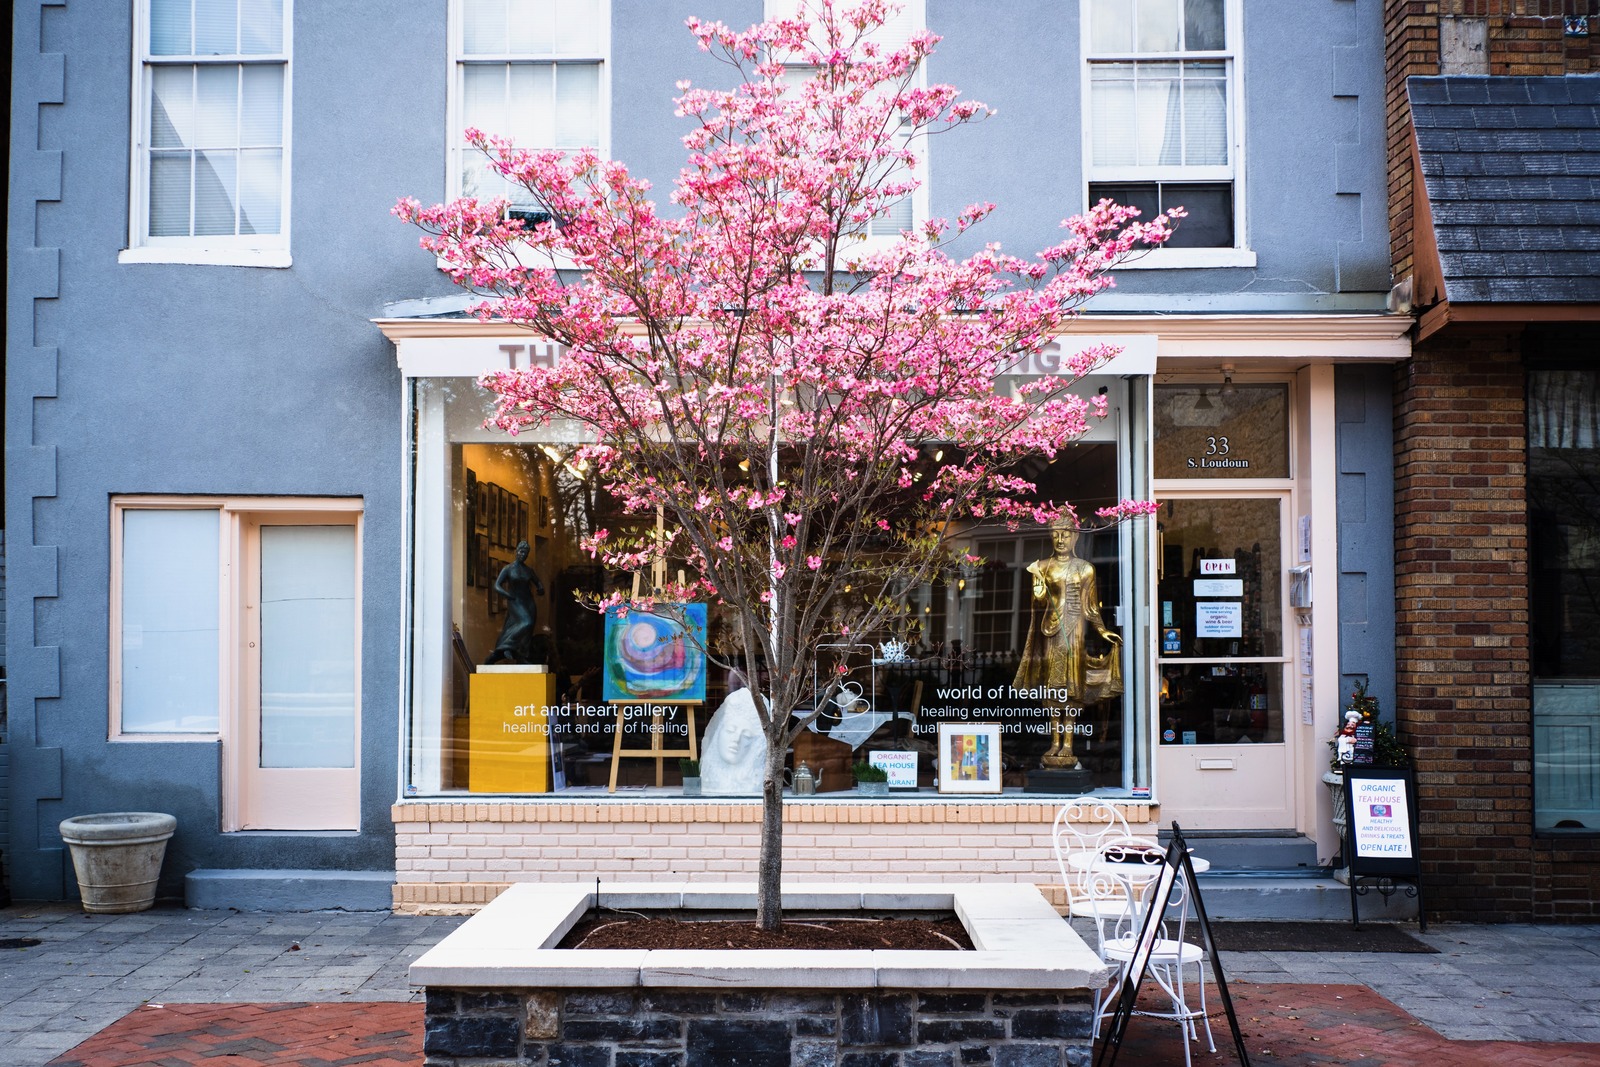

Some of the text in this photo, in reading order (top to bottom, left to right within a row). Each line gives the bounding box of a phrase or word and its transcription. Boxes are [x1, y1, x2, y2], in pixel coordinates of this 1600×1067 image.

[499, 344, 572, 369] TH
[1206, 436, 1229, 455] 33
[1188, 457, 1249, 468] S. Loudoun
[1205, 562, 1231, 571] OPEN
[936, 685, 1068, 703] world of healing
[514, 702, 678, 720] art and heart gallery
[921, 705, 1083, 720] healing environments for
[503, 721, 688, 736] healing art and art of healing
[911, 721, 944, 736] qual
[999, 722, 1022, 734] and
[1025, 721, 1093, 736] well-being
[1361, 784, 1396, 792] ORGANIC
[1358, 795, 1401, 804] TEA HOUSE
